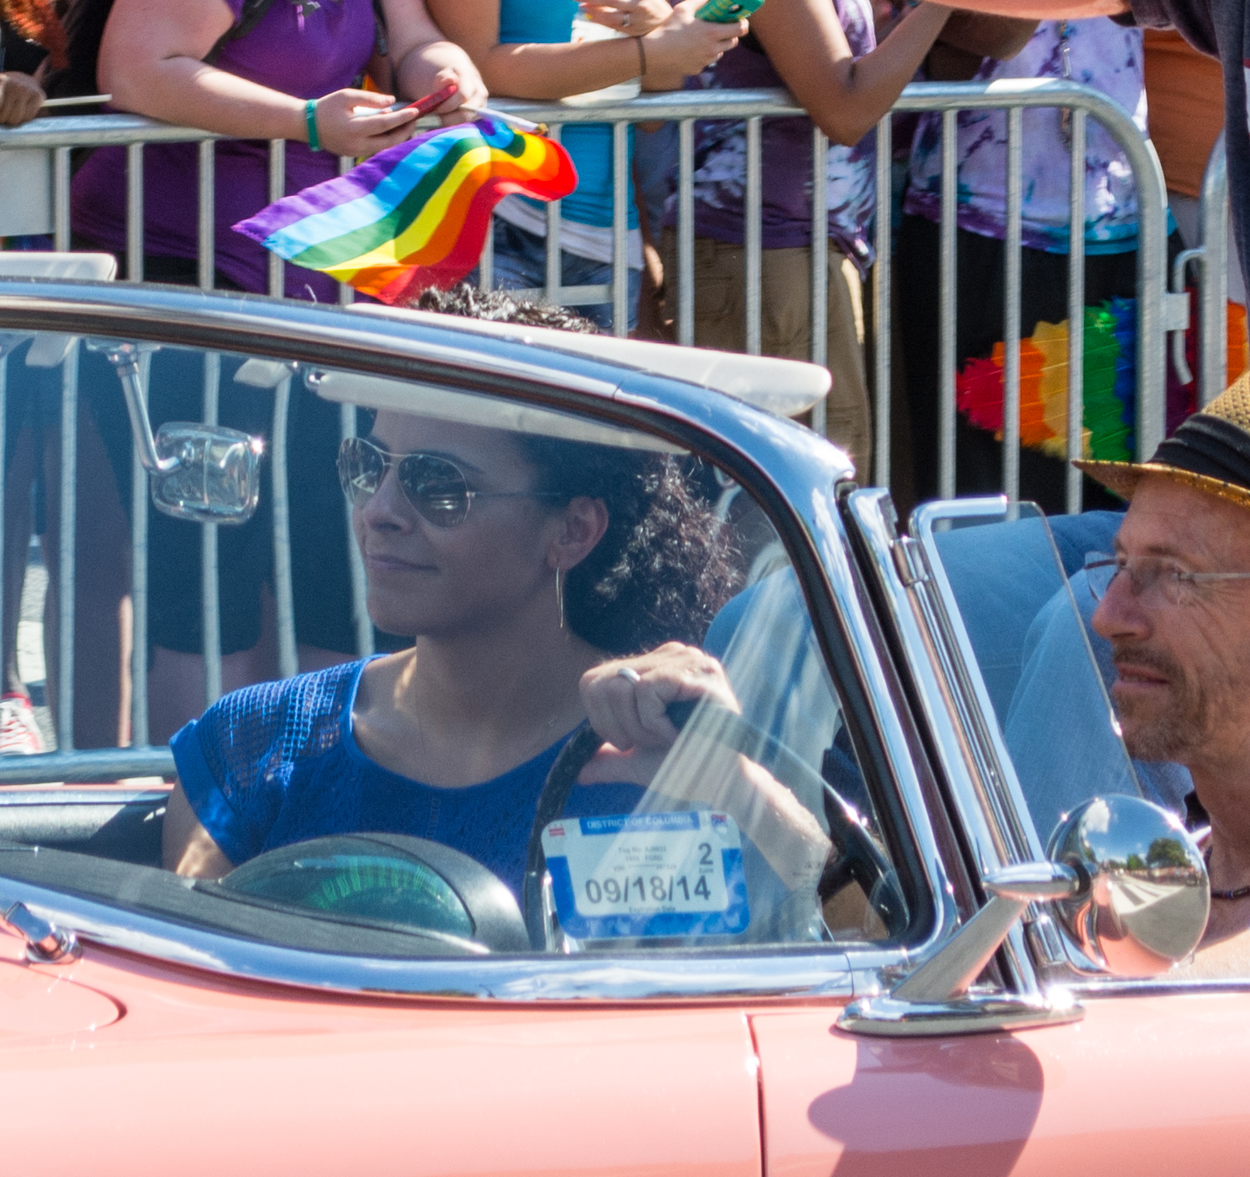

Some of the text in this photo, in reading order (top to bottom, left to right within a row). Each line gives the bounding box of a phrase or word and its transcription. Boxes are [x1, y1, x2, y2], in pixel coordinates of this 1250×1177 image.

[586, 814, 693, 830] DISTRICT OF COLUMBIA
[698, 842, 714, 866] 2
[585, 875, 711, 904] 09/18/14
